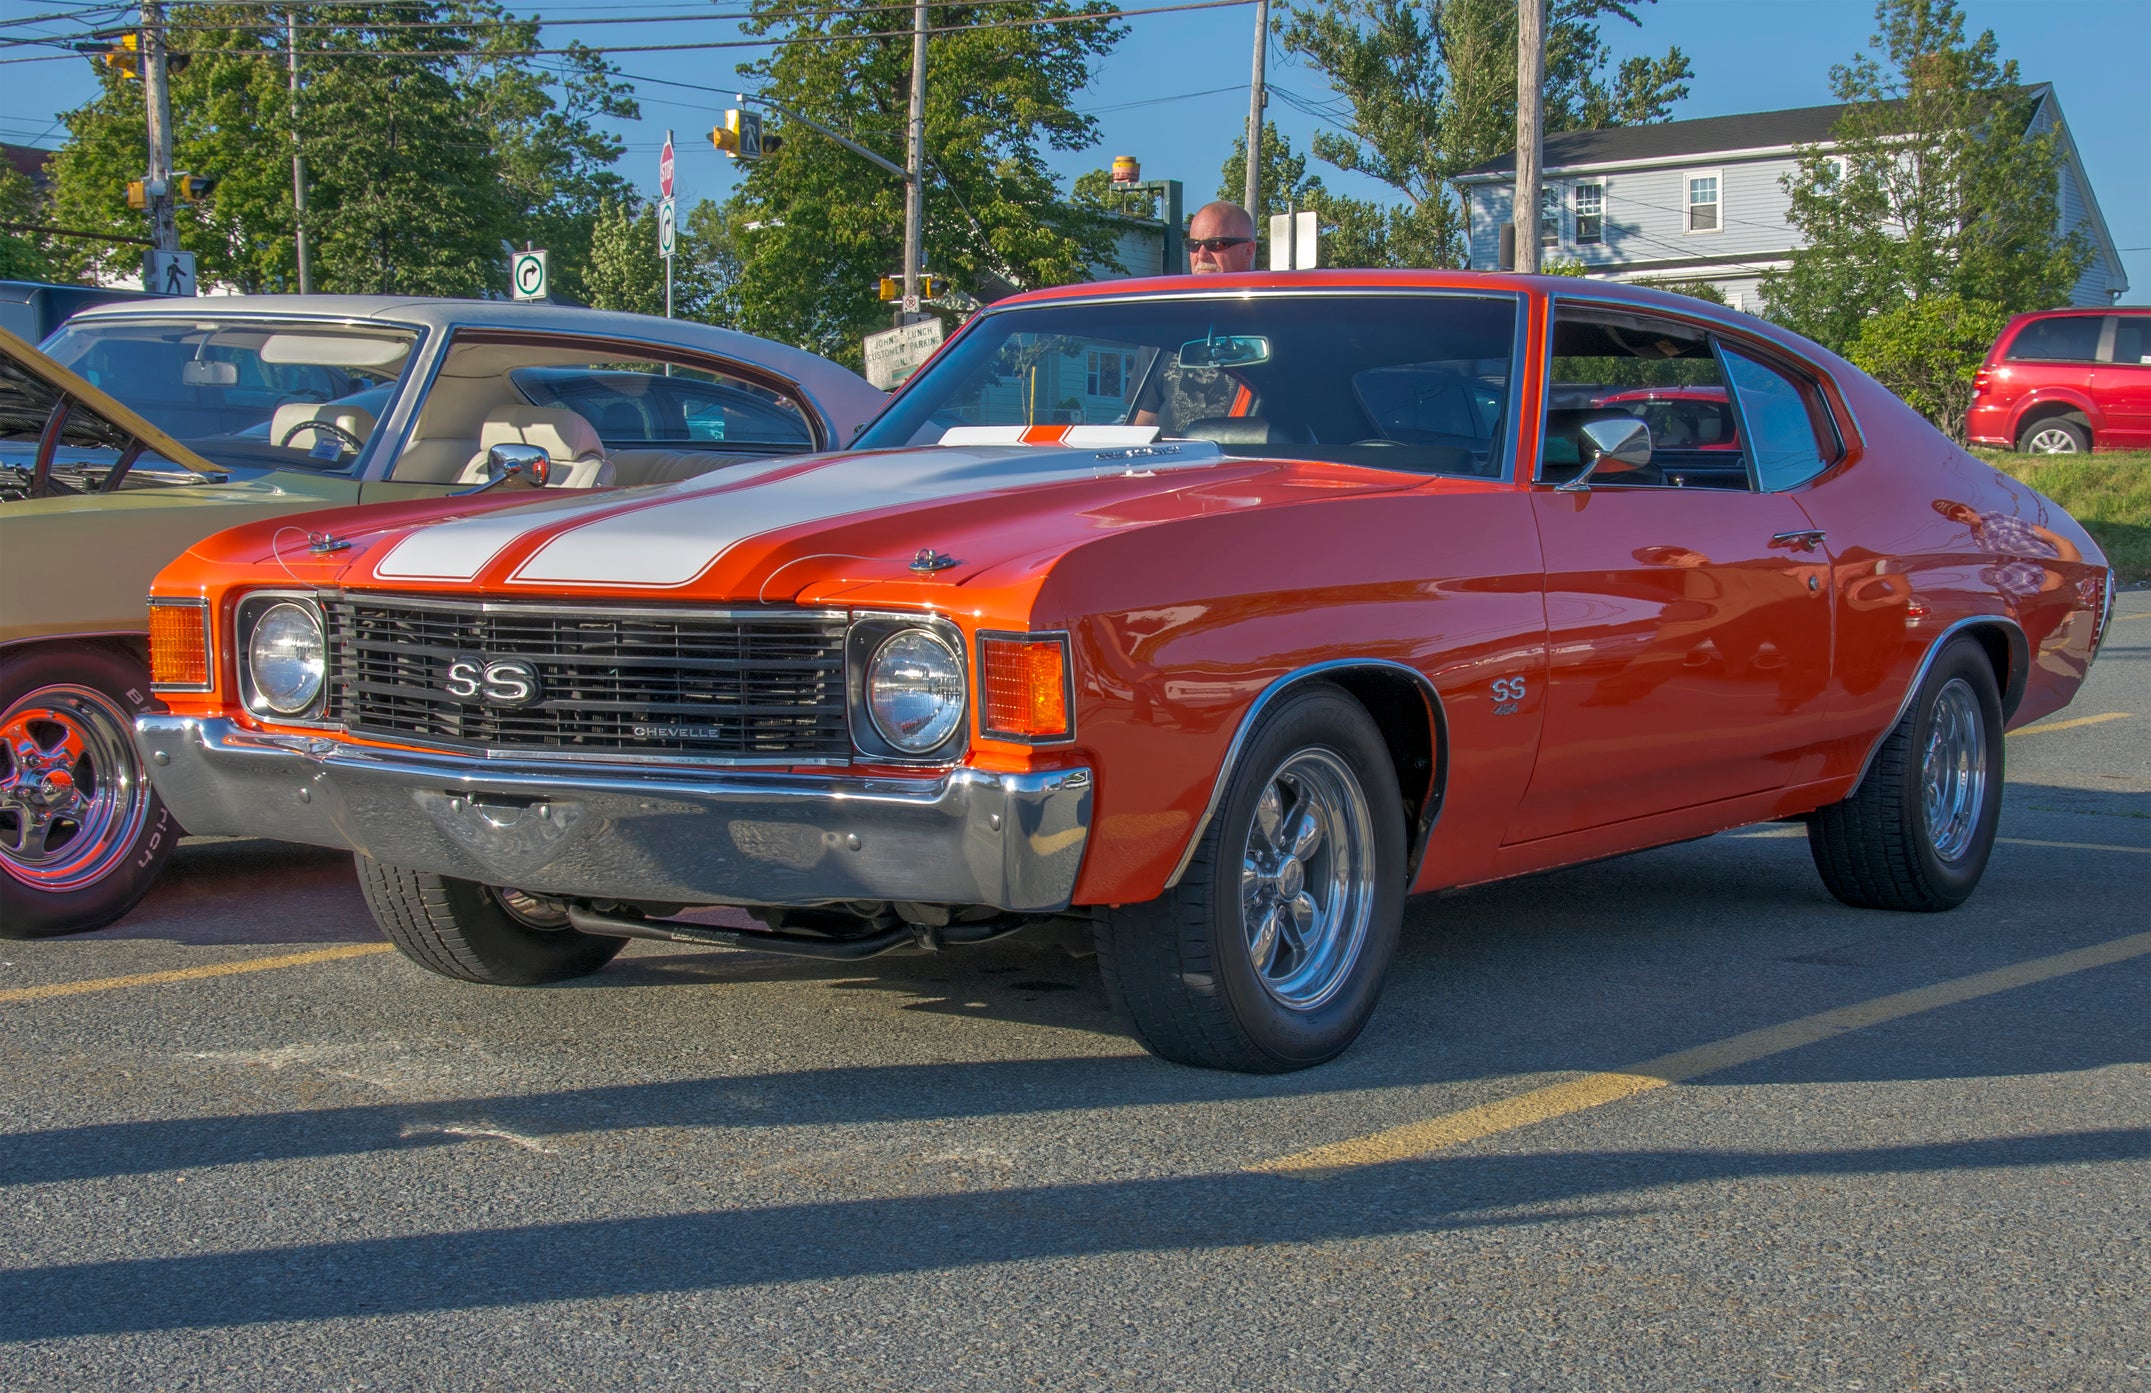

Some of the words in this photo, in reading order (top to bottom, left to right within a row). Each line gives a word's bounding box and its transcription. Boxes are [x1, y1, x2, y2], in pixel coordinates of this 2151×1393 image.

[661, 159, 673, 182] STOP
[907, 327, 933, 340] LUNCH
[867, 344, 905, 362] CUSTOMER
[910, 336, 940, 350] PARKING
[895, 356, 914, 367] ONLY
[446, 657, 538, 702] SS
[1490, 676, 1526, 702] SS
[634, 727, 719, 738] CHEVELLE
